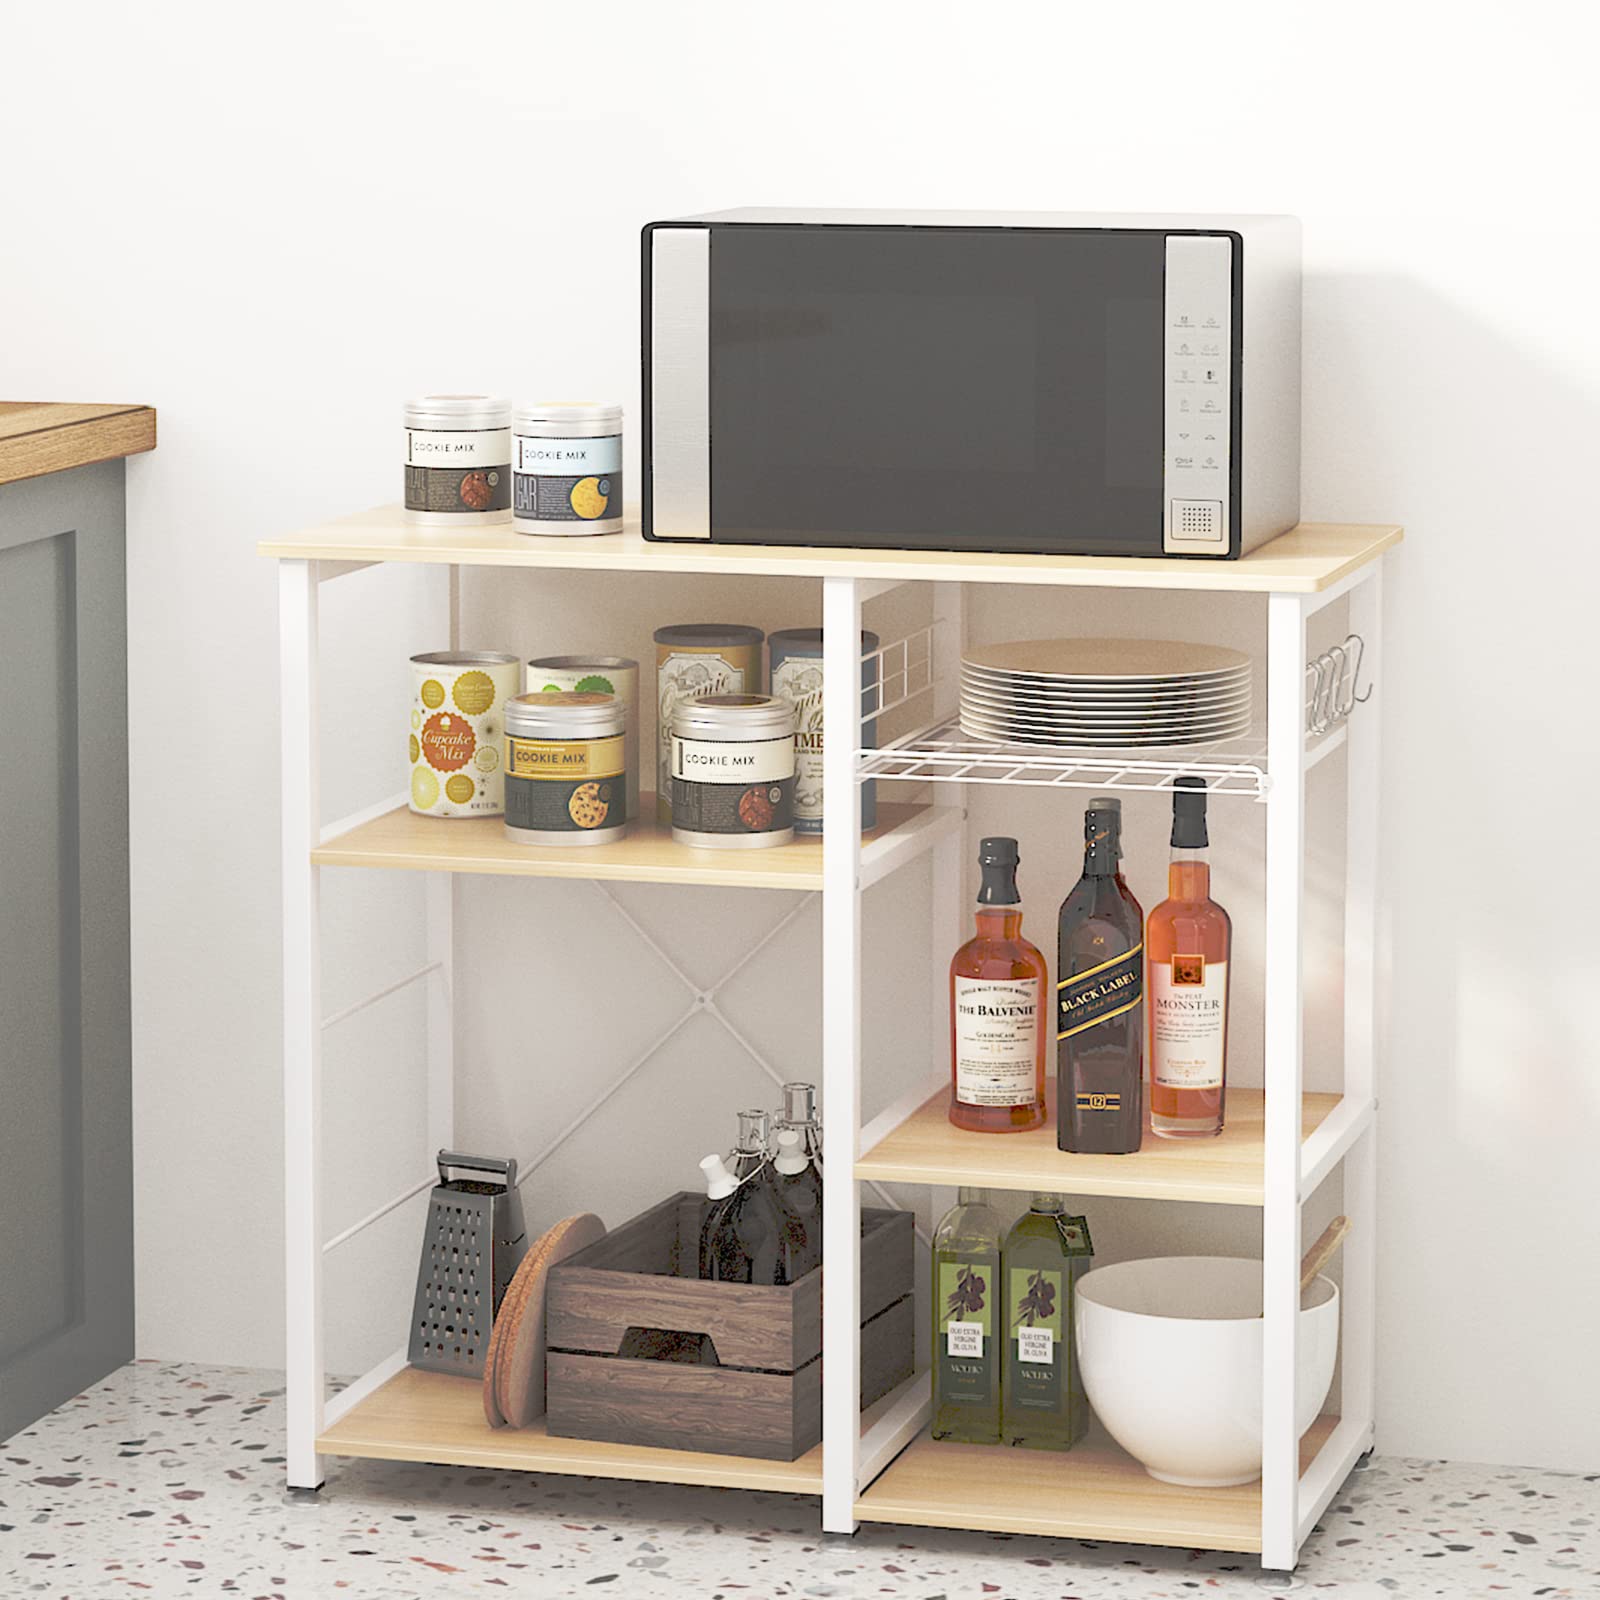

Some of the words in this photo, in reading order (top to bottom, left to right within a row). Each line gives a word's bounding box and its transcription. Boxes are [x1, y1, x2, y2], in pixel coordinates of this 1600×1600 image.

[414, 442, 451, 452] COOKIE
[454, 443, 475, 453] MIX
[525, 449, 562, 460] COOKIE
[566, 451, 587, 460] MIX
[423, 729, 472, 748] Cupcake
[435, 744, 466, 761] Mix
[516, 752, 559, 763] COOKIE
[562, 753, 585, 763] MIX
[685, 754, 728, 765] COOKIE
[732, 756, 755, 765] MIX
[1060, 988, 1100, 1013] BLACK
[1099, 971, 1137, 995] LABEL
[1157, 998, 1220, 1011] MONSTER
[959, 1005, 976, 1015] THE
[978, 1004, 1037, 1017] BALVENIE
[963, 1328, 980, 1336] EXTRA
[1033, 1334, 1051, 1342] EXTRA
